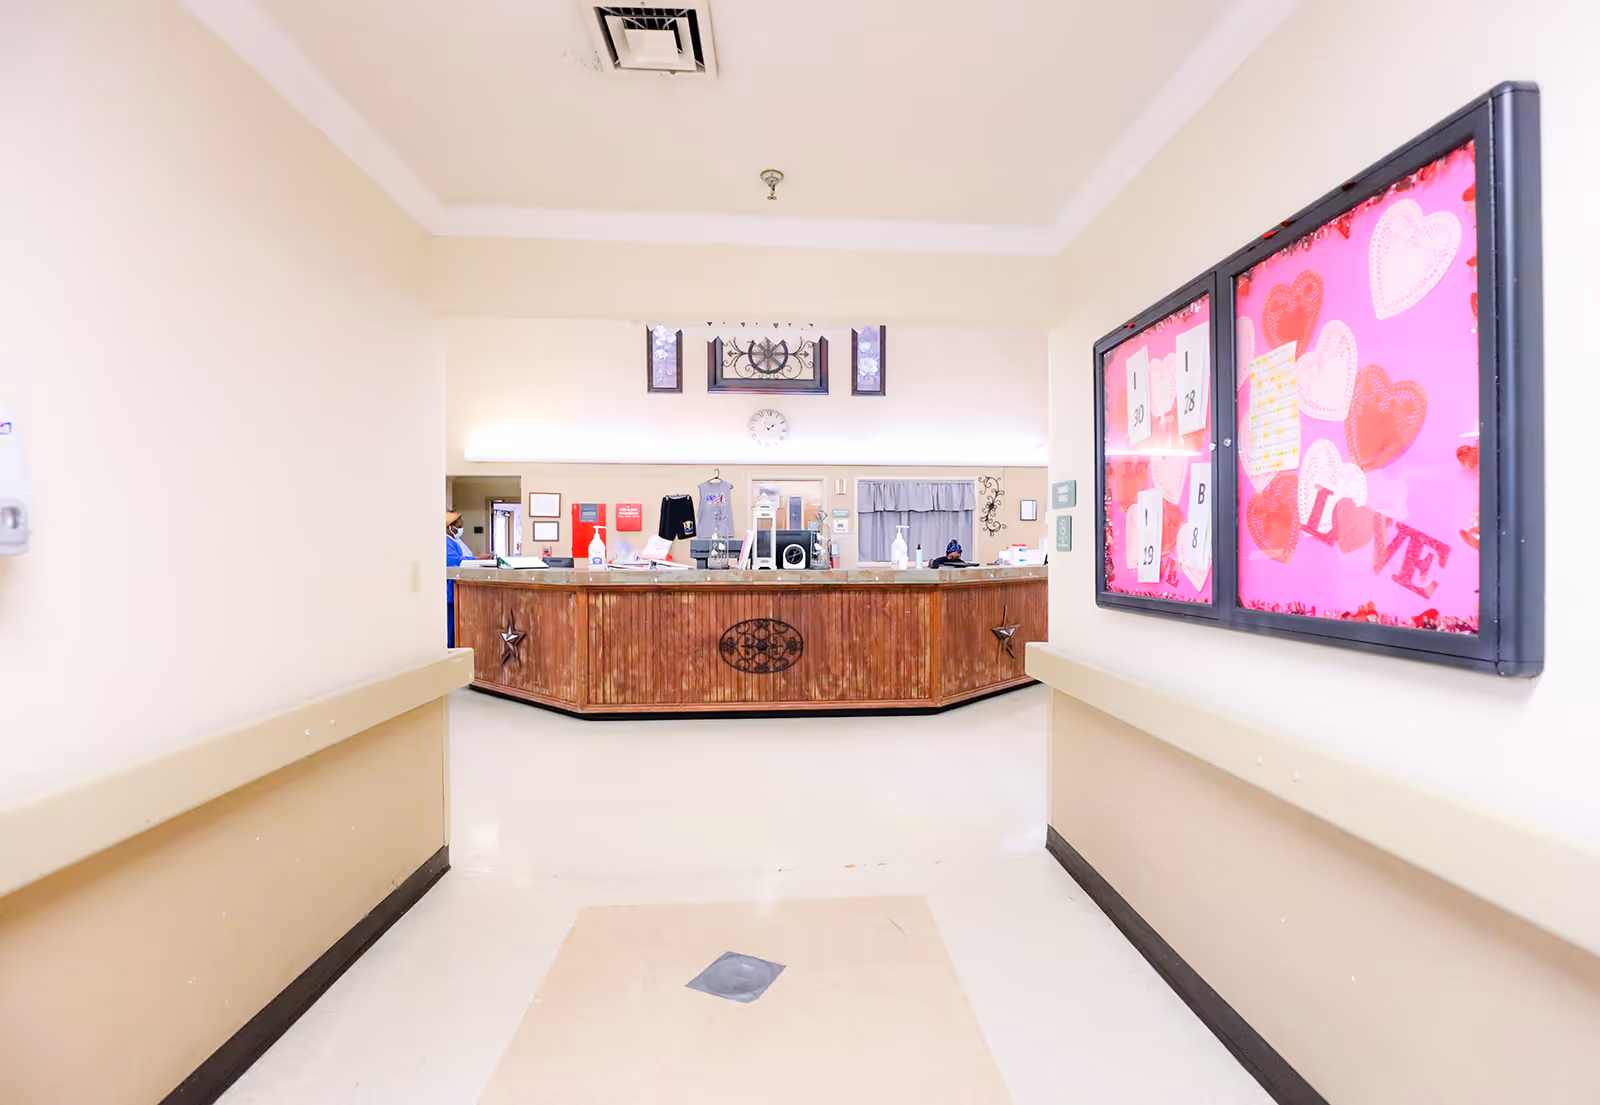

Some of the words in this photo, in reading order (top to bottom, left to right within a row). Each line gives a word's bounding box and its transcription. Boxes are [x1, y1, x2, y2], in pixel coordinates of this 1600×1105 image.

[1183, 389, 1196, 416] 28
[1133, 404, 1145, 427] 30
[1197, 482, 1206, 505] B
[1191, 527, 1199, 549] 8
[1143, 545, 1154, 566] 19
